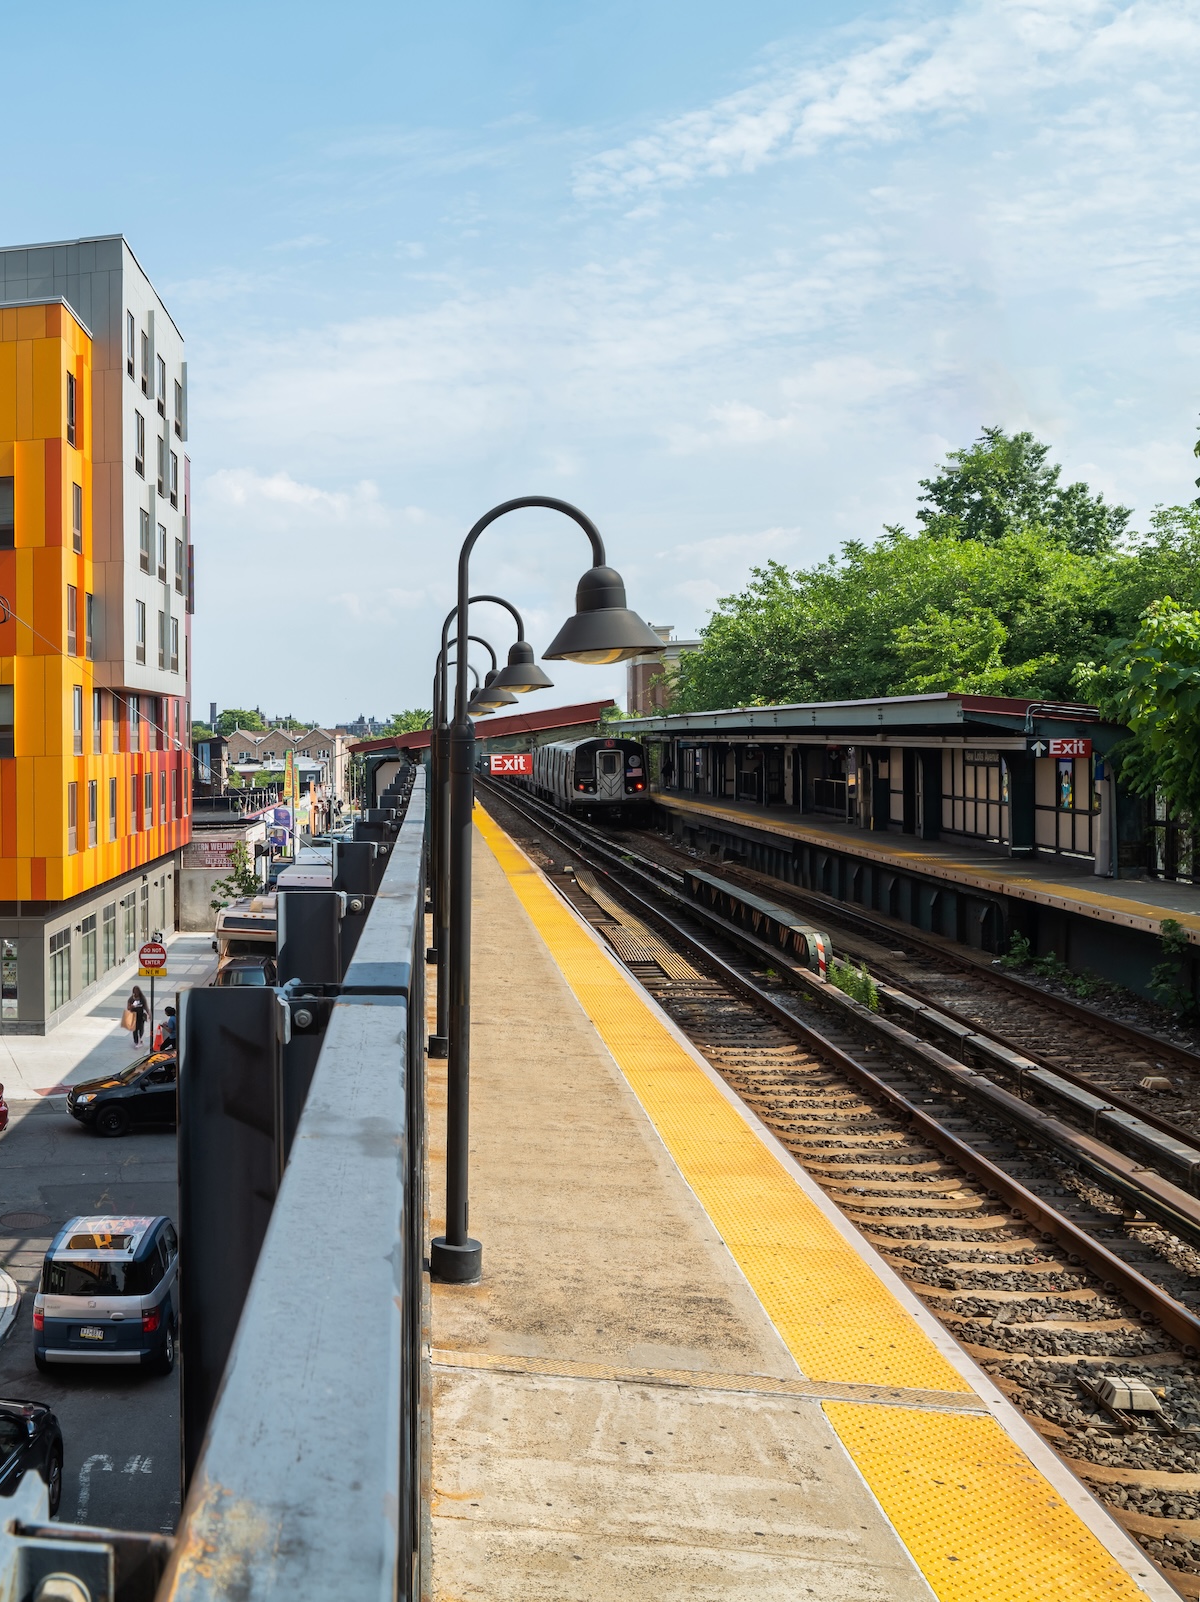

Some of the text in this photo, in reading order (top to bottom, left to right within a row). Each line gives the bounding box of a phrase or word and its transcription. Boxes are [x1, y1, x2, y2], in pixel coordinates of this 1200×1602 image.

[1049, 739, 1085, 755] Exit
[490, 755, 526, 771] Exit
[974, 751, 984, 762] Lots
[985, 752, 999, 762] Avenue
[210, 842, 237, 851] WELDIN
